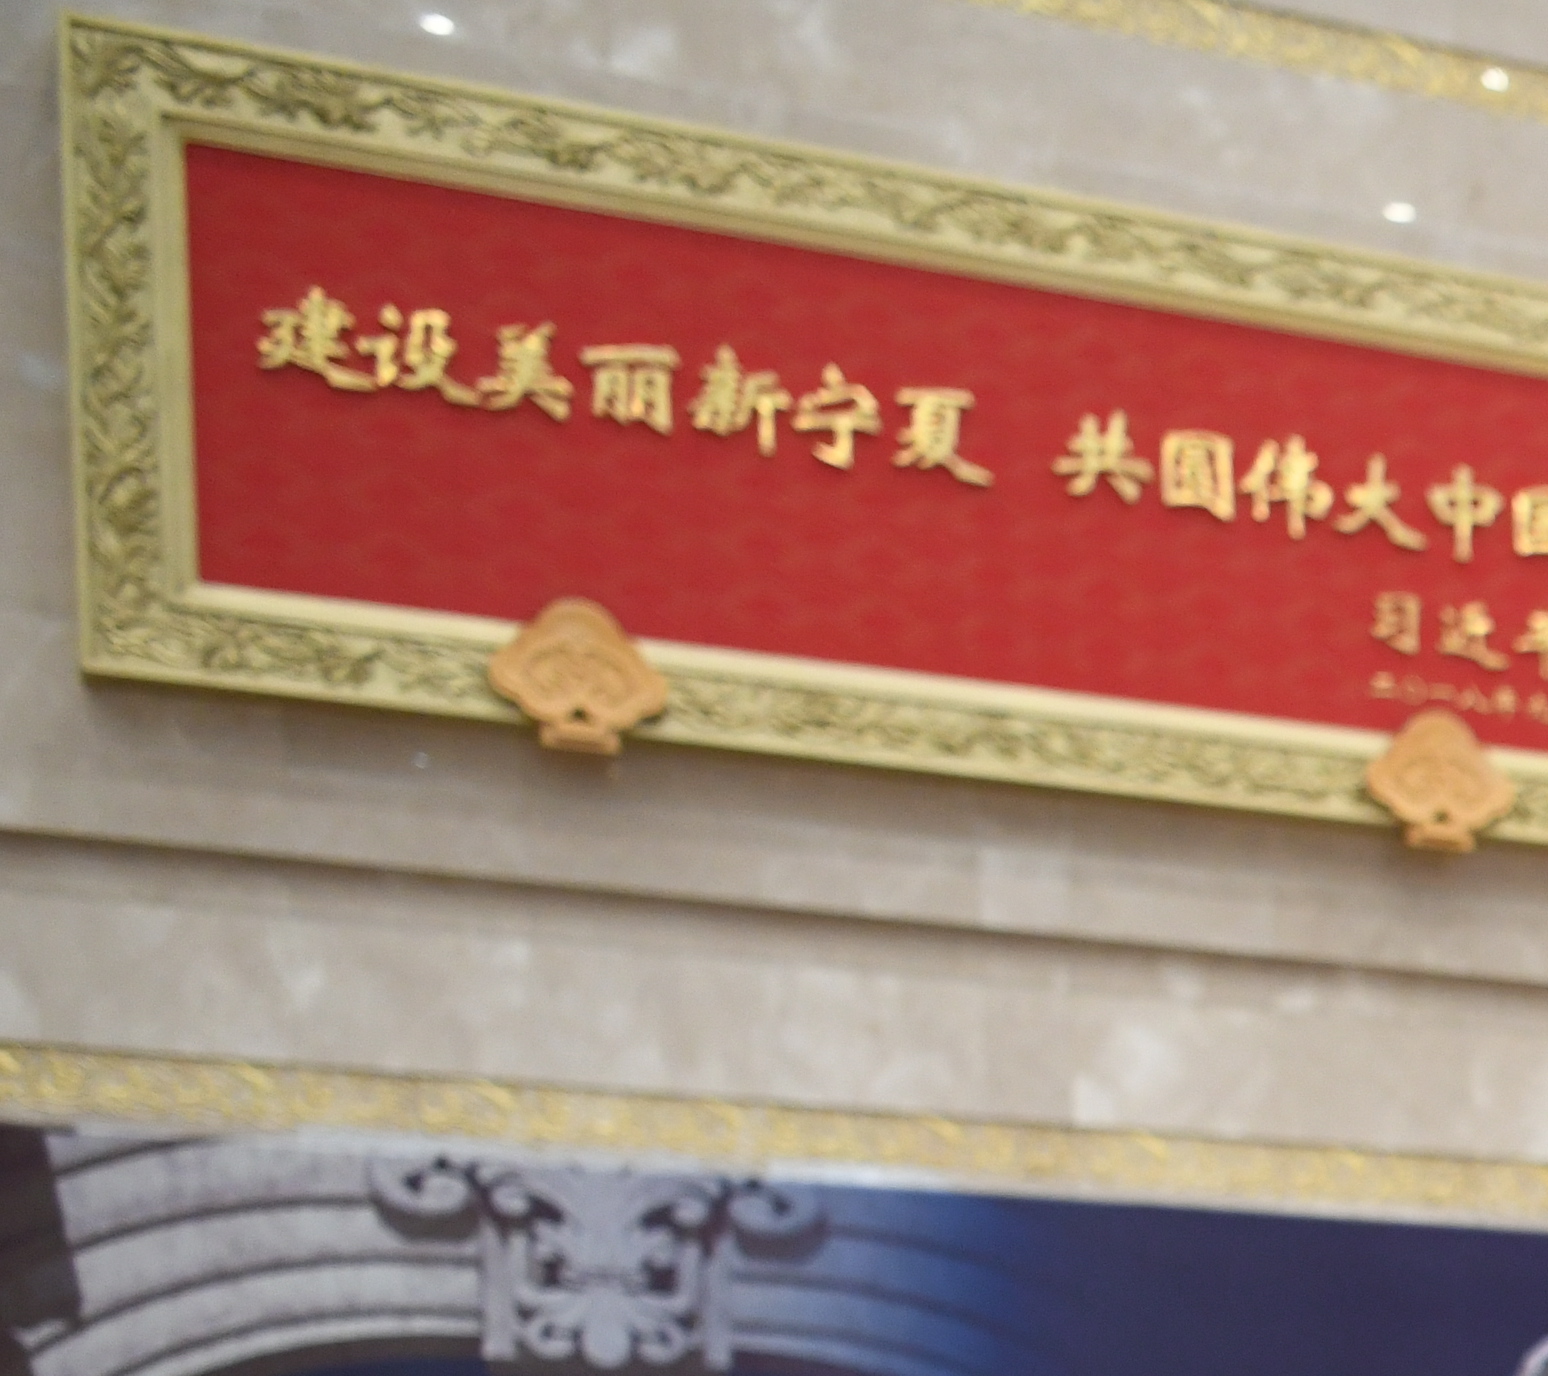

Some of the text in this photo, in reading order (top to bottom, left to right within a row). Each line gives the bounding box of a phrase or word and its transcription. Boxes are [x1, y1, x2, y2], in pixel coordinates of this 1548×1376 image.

[257, 284, 995, 488] 建设美丽新宁夏
